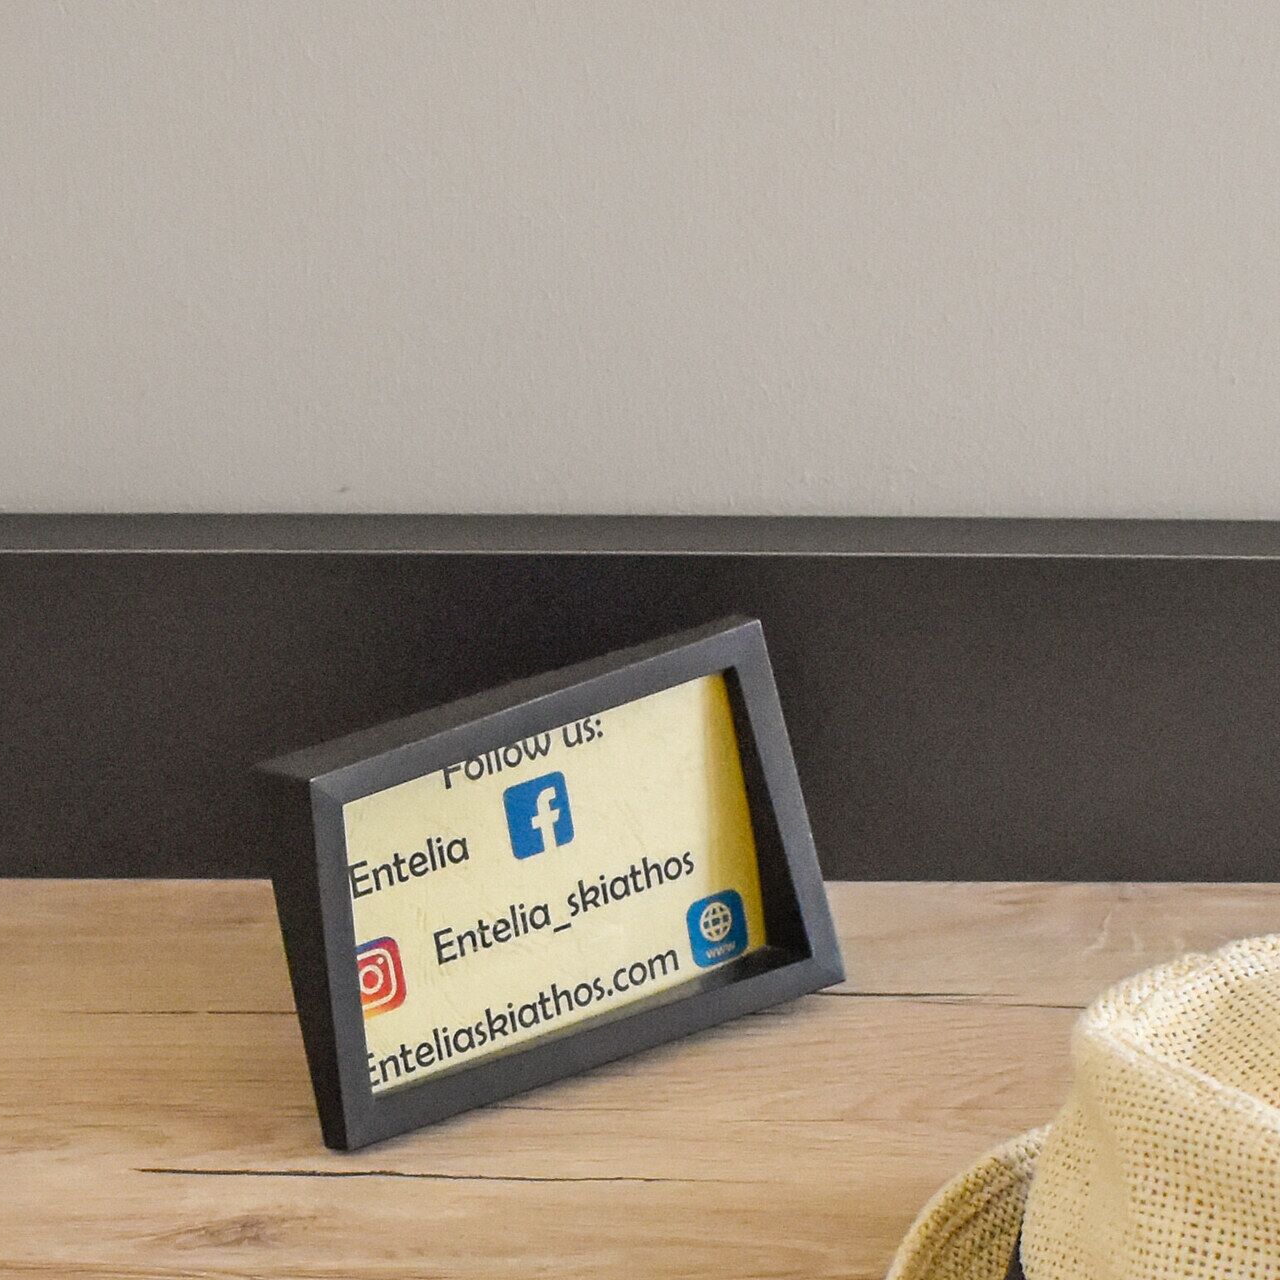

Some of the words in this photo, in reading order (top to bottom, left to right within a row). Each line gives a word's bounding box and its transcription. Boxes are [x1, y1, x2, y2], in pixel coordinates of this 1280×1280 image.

[562, 717, 604, 749] us:
[348, 836, 470, 900] Entelia
[432, 850, 695, 966] Entelia_skiathos
